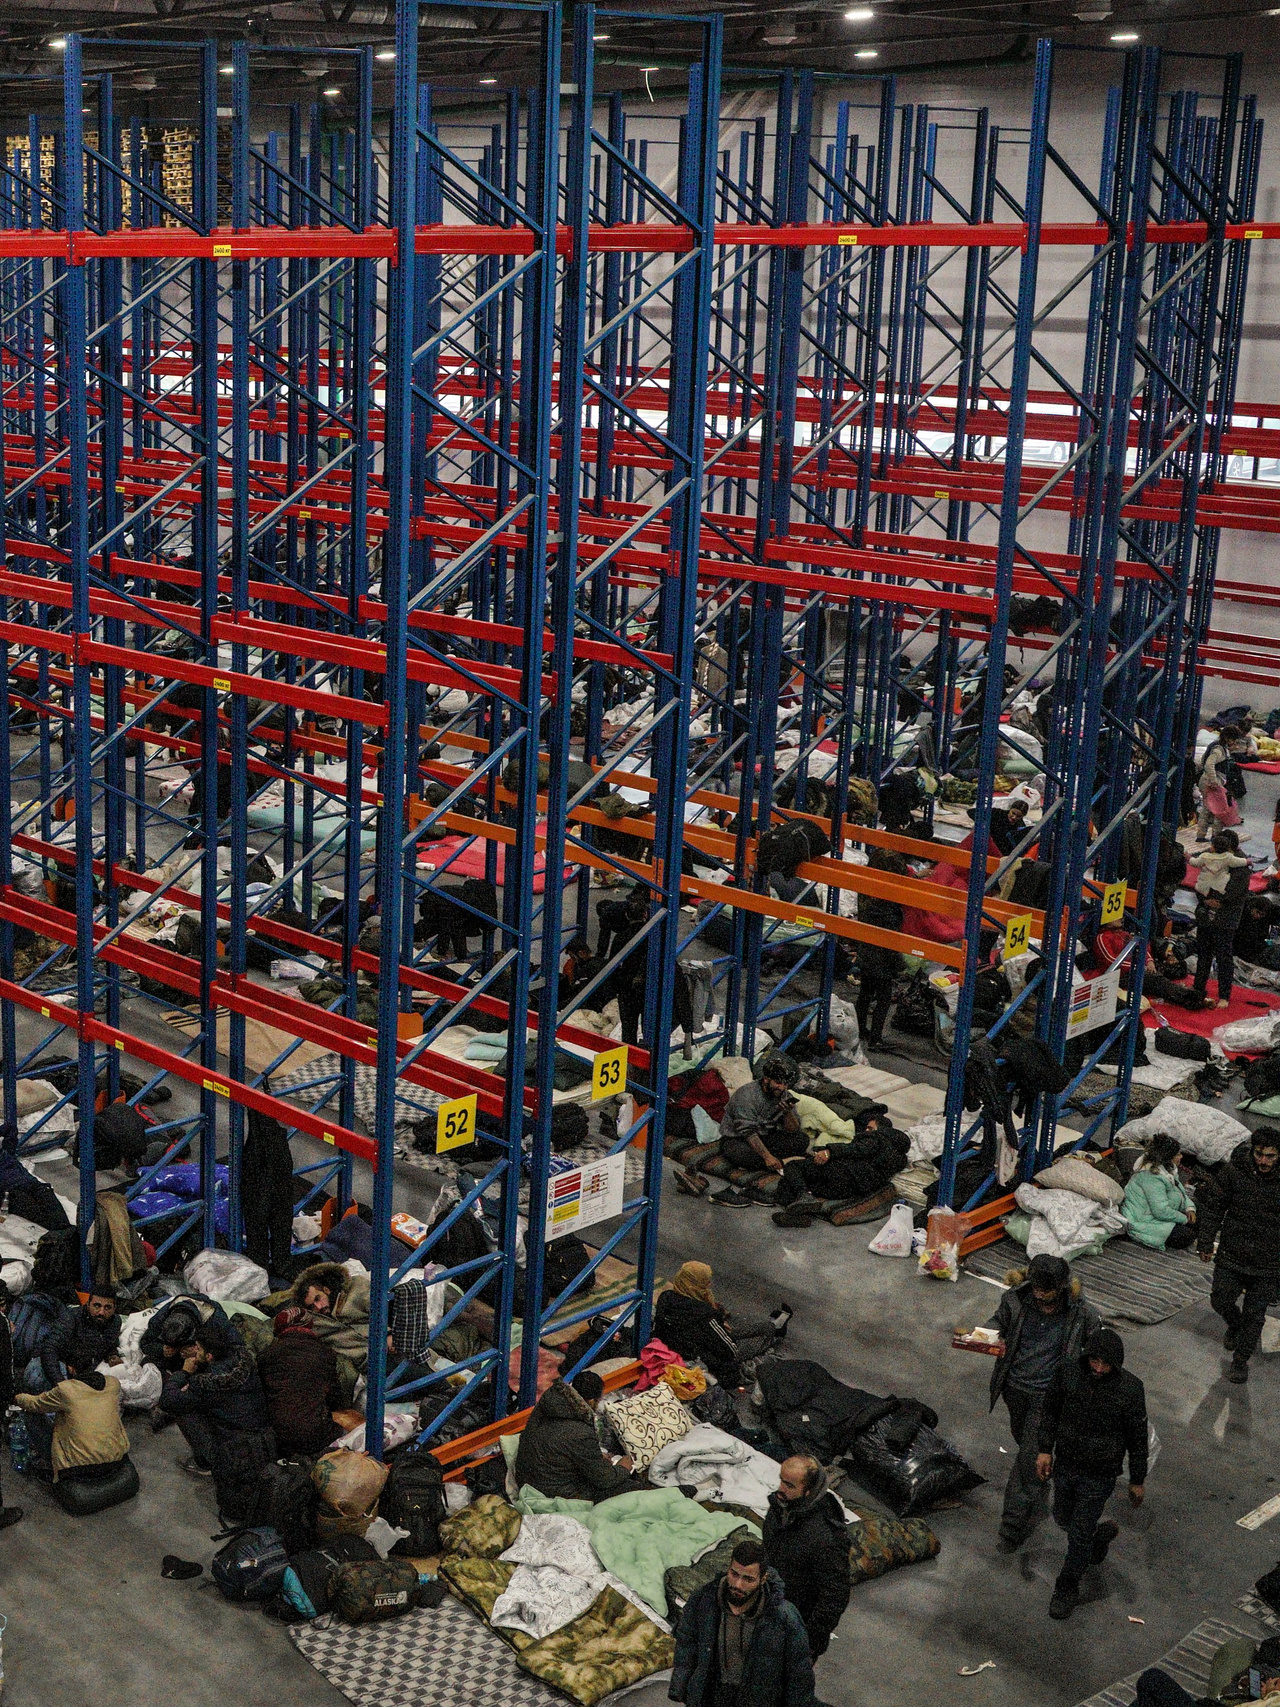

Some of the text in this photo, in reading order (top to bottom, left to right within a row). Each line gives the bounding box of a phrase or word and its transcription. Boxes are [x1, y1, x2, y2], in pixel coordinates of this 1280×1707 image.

[214, 680, 224, 688] 2400
[1106, 892, 1121, 914] 55
[1010, 925, 1025, 949] 54
[599, 1060, 619, 1088] 53
[444, 1109, 468, 1138] 52
